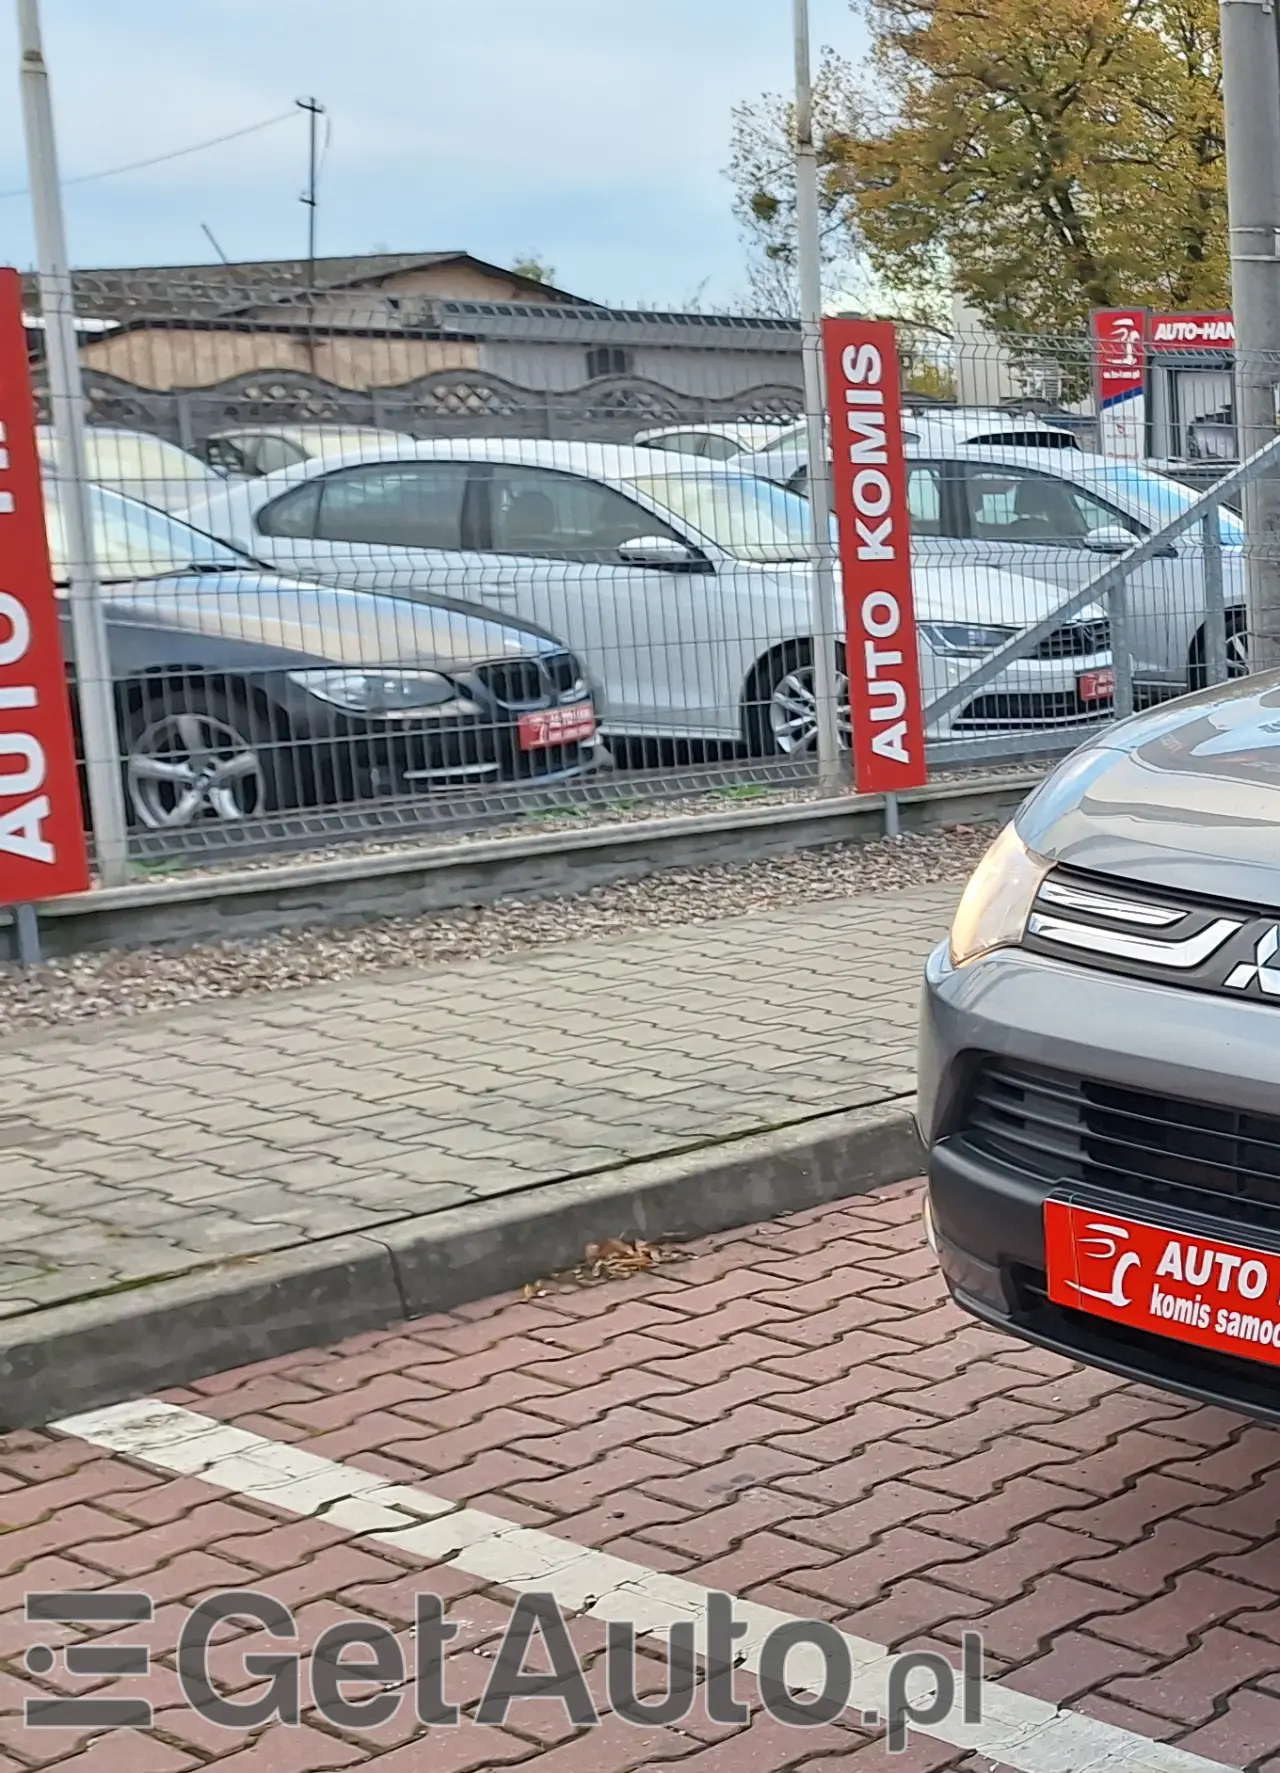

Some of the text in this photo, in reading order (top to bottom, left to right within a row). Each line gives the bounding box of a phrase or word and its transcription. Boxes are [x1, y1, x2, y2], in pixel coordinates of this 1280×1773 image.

[841, 342, 910, 764] AUTO KOMIS
[1155, 1241, 1268, 1300] AUTO
[1150, 1284, 1211, 1329] komis
